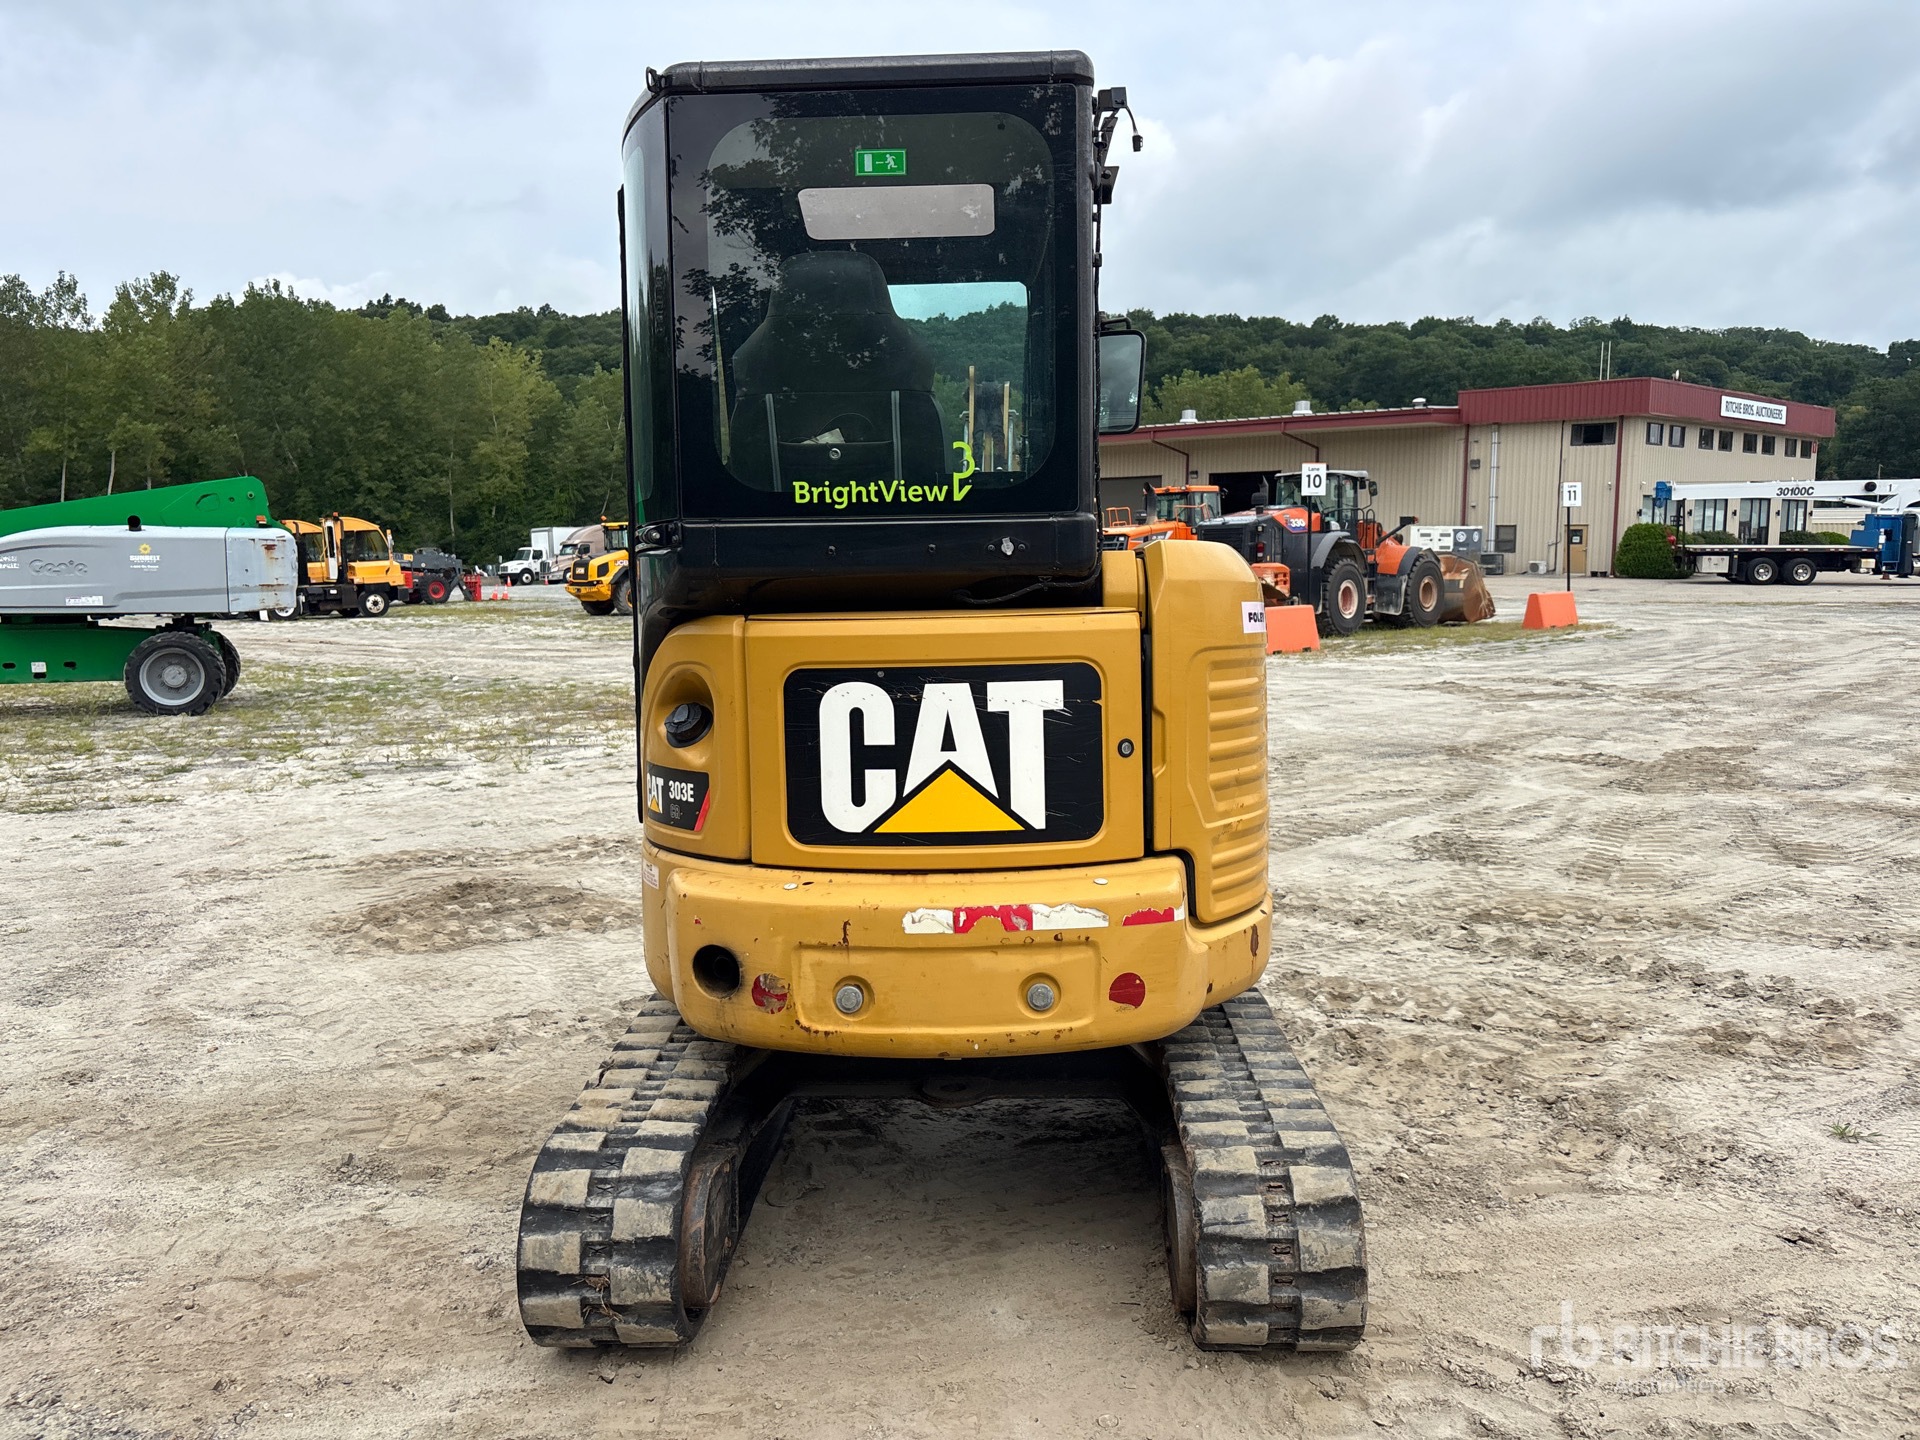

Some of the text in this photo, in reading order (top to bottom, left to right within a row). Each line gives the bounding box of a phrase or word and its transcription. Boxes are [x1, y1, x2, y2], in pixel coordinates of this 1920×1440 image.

[1725, 400, 1742, 414] RITCHIE
[1755, 405, 1784, 420] AUCTIONEERS
[1306, 474, 1322, 489] 10
[793, 480, 948, 509] BrightView
[1567, 490, 1577, 501] 11
[1776, 486, 1815, 497] 30100C
[1290, 518, 1306, 529] 330
[29, 559, 88, 576] Genie
[819, 680, 1064, 834] CAT
[646, 773, 664, 814] CAT
[668, 780, 695, 803] 303E
